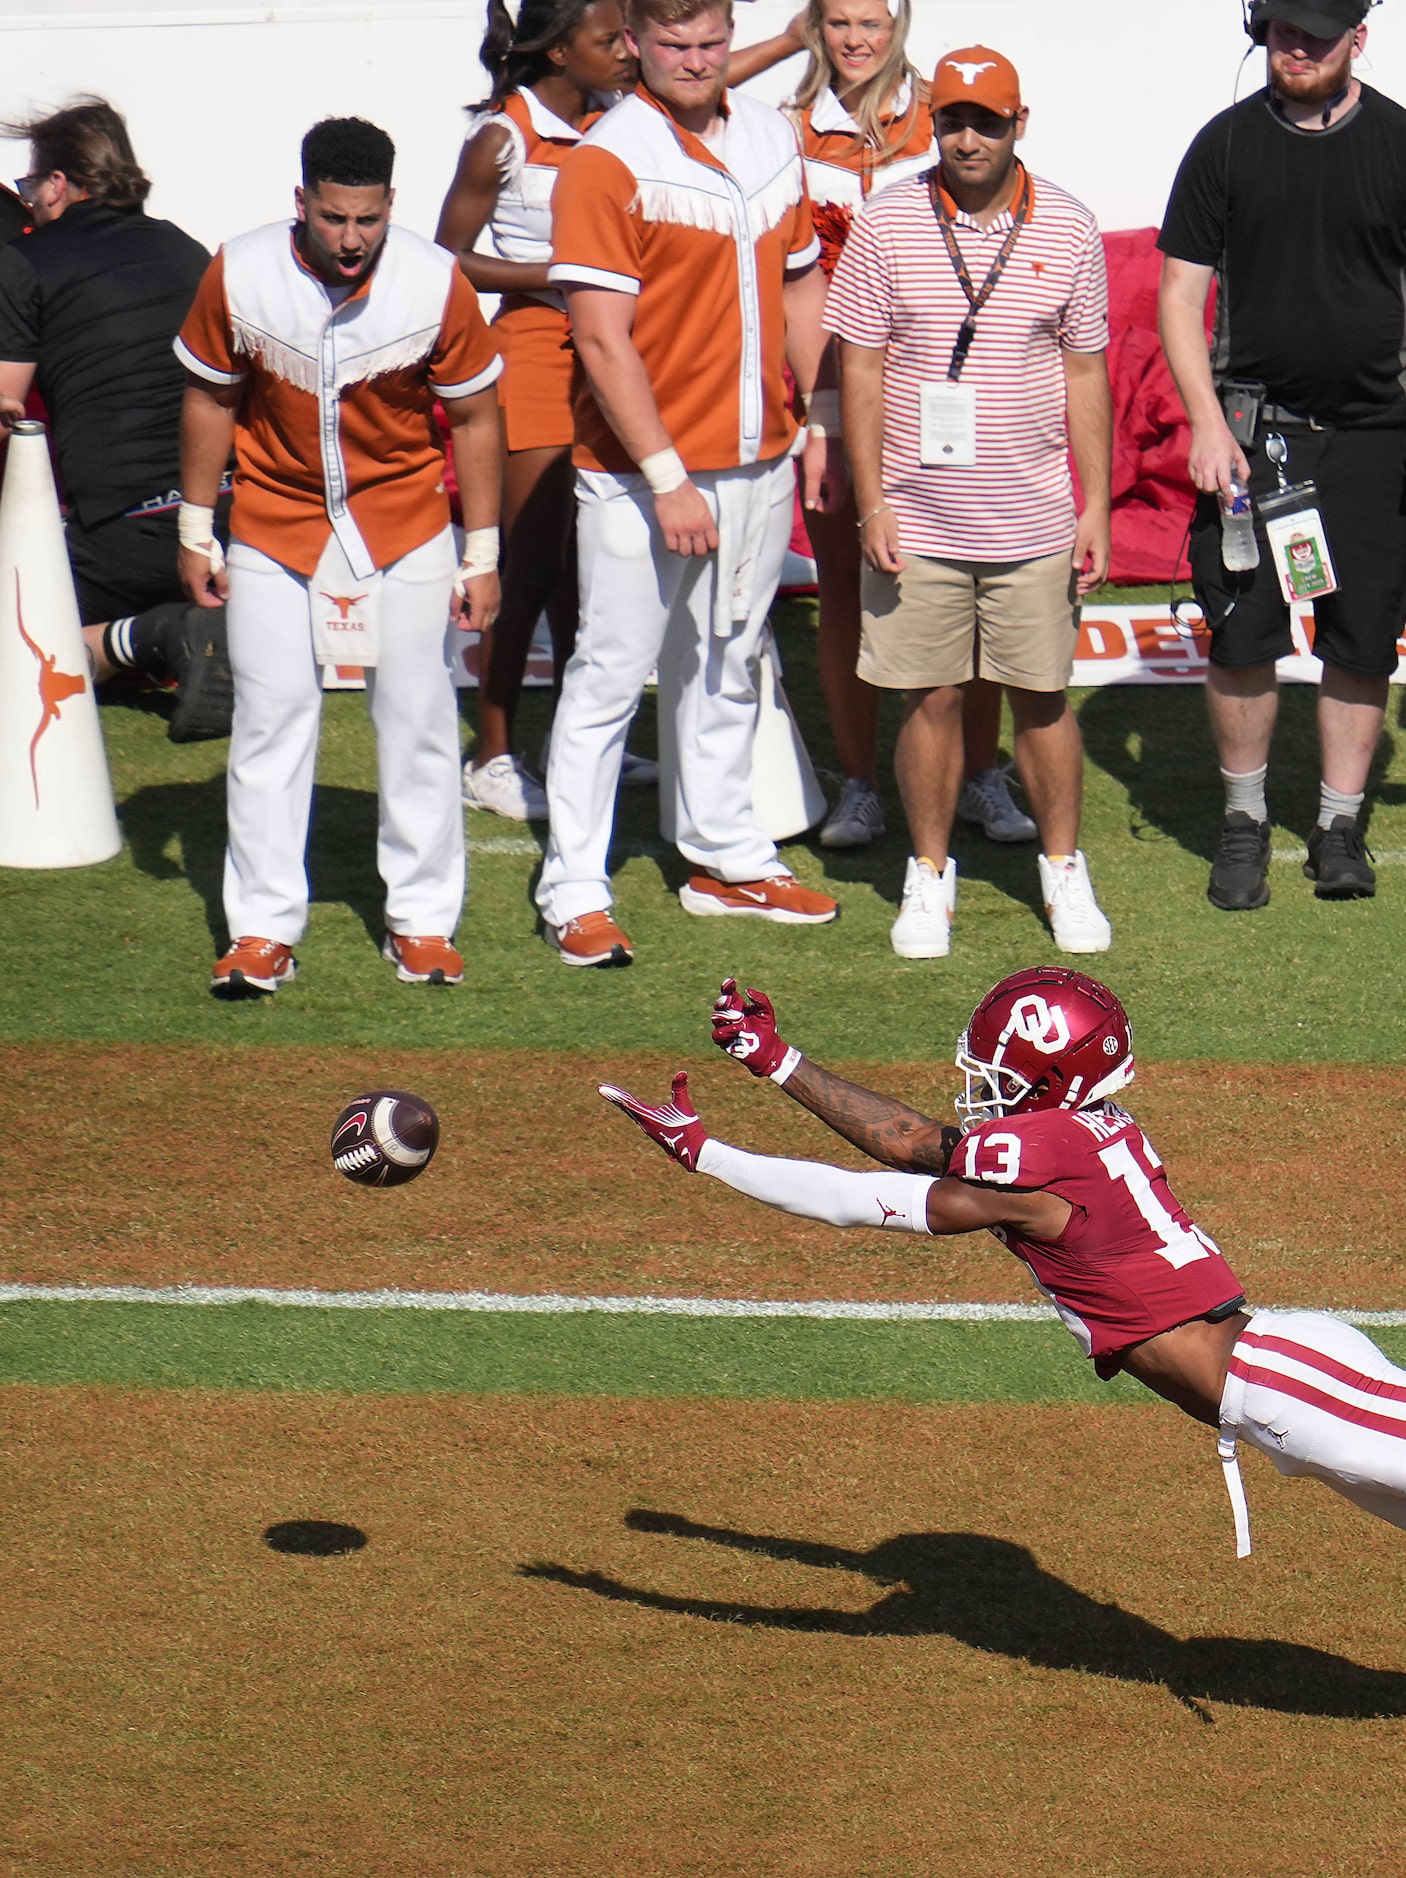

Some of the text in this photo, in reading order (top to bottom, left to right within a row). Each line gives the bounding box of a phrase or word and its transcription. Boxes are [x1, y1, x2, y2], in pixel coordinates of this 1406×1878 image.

[326, 621, 365, 631] TEXAS
[1010, 994, 1071, 1055] OU
[963, 1132, 1022, 1185] 13
